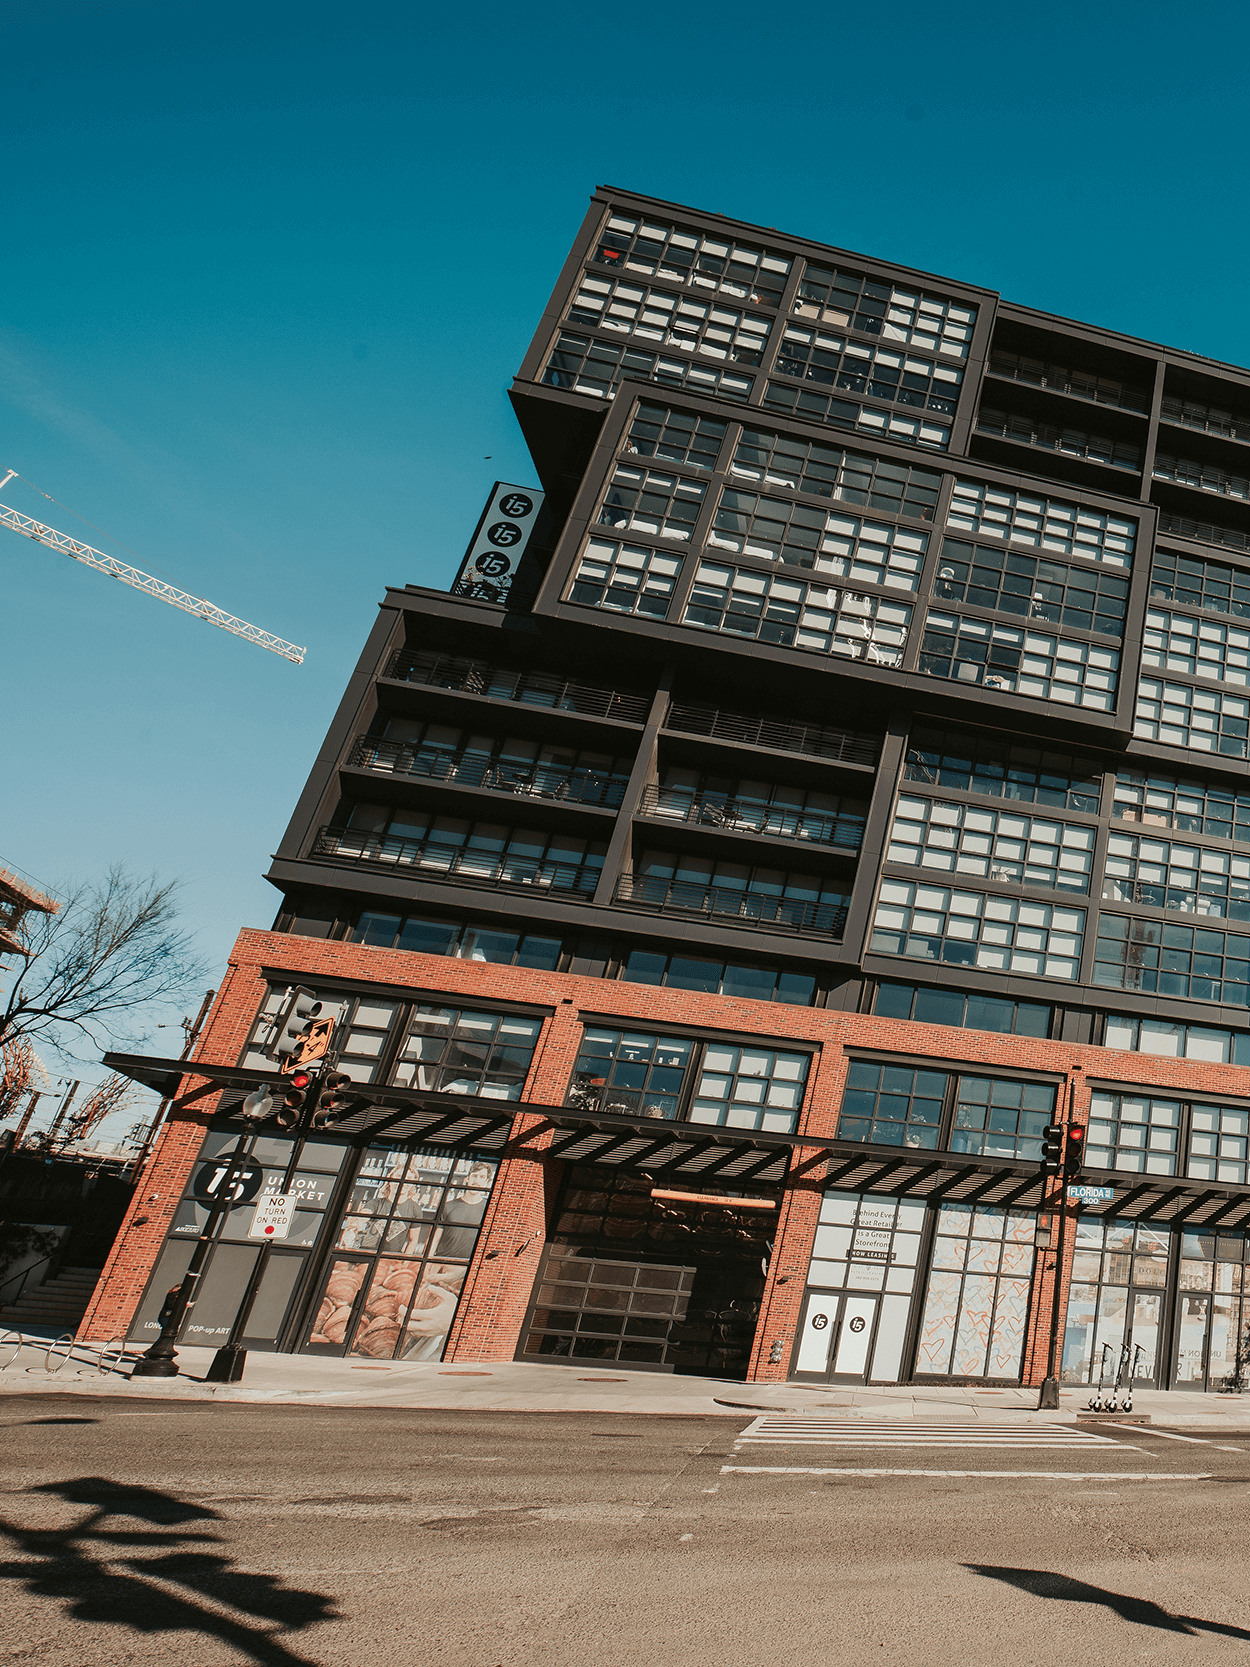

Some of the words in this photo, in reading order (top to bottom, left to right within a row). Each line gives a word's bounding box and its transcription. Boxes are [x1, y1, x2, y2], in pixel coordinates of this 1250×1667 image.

[1070, 1187, 1104, 1198] FLORIDA
[269, 1197, 285, 1206] NO
[265, 1207, 286, 1215] TURN
[852, 1208, 879, 1218] Behind
[257, 1216, 268, 1224] ON
[271, 1216, 288, 1225] RED
[871, 1231, 890, 1239] Great
[187, 1324, 215, 1335] POP-up
[215, 1327, 230, 1335] ART
